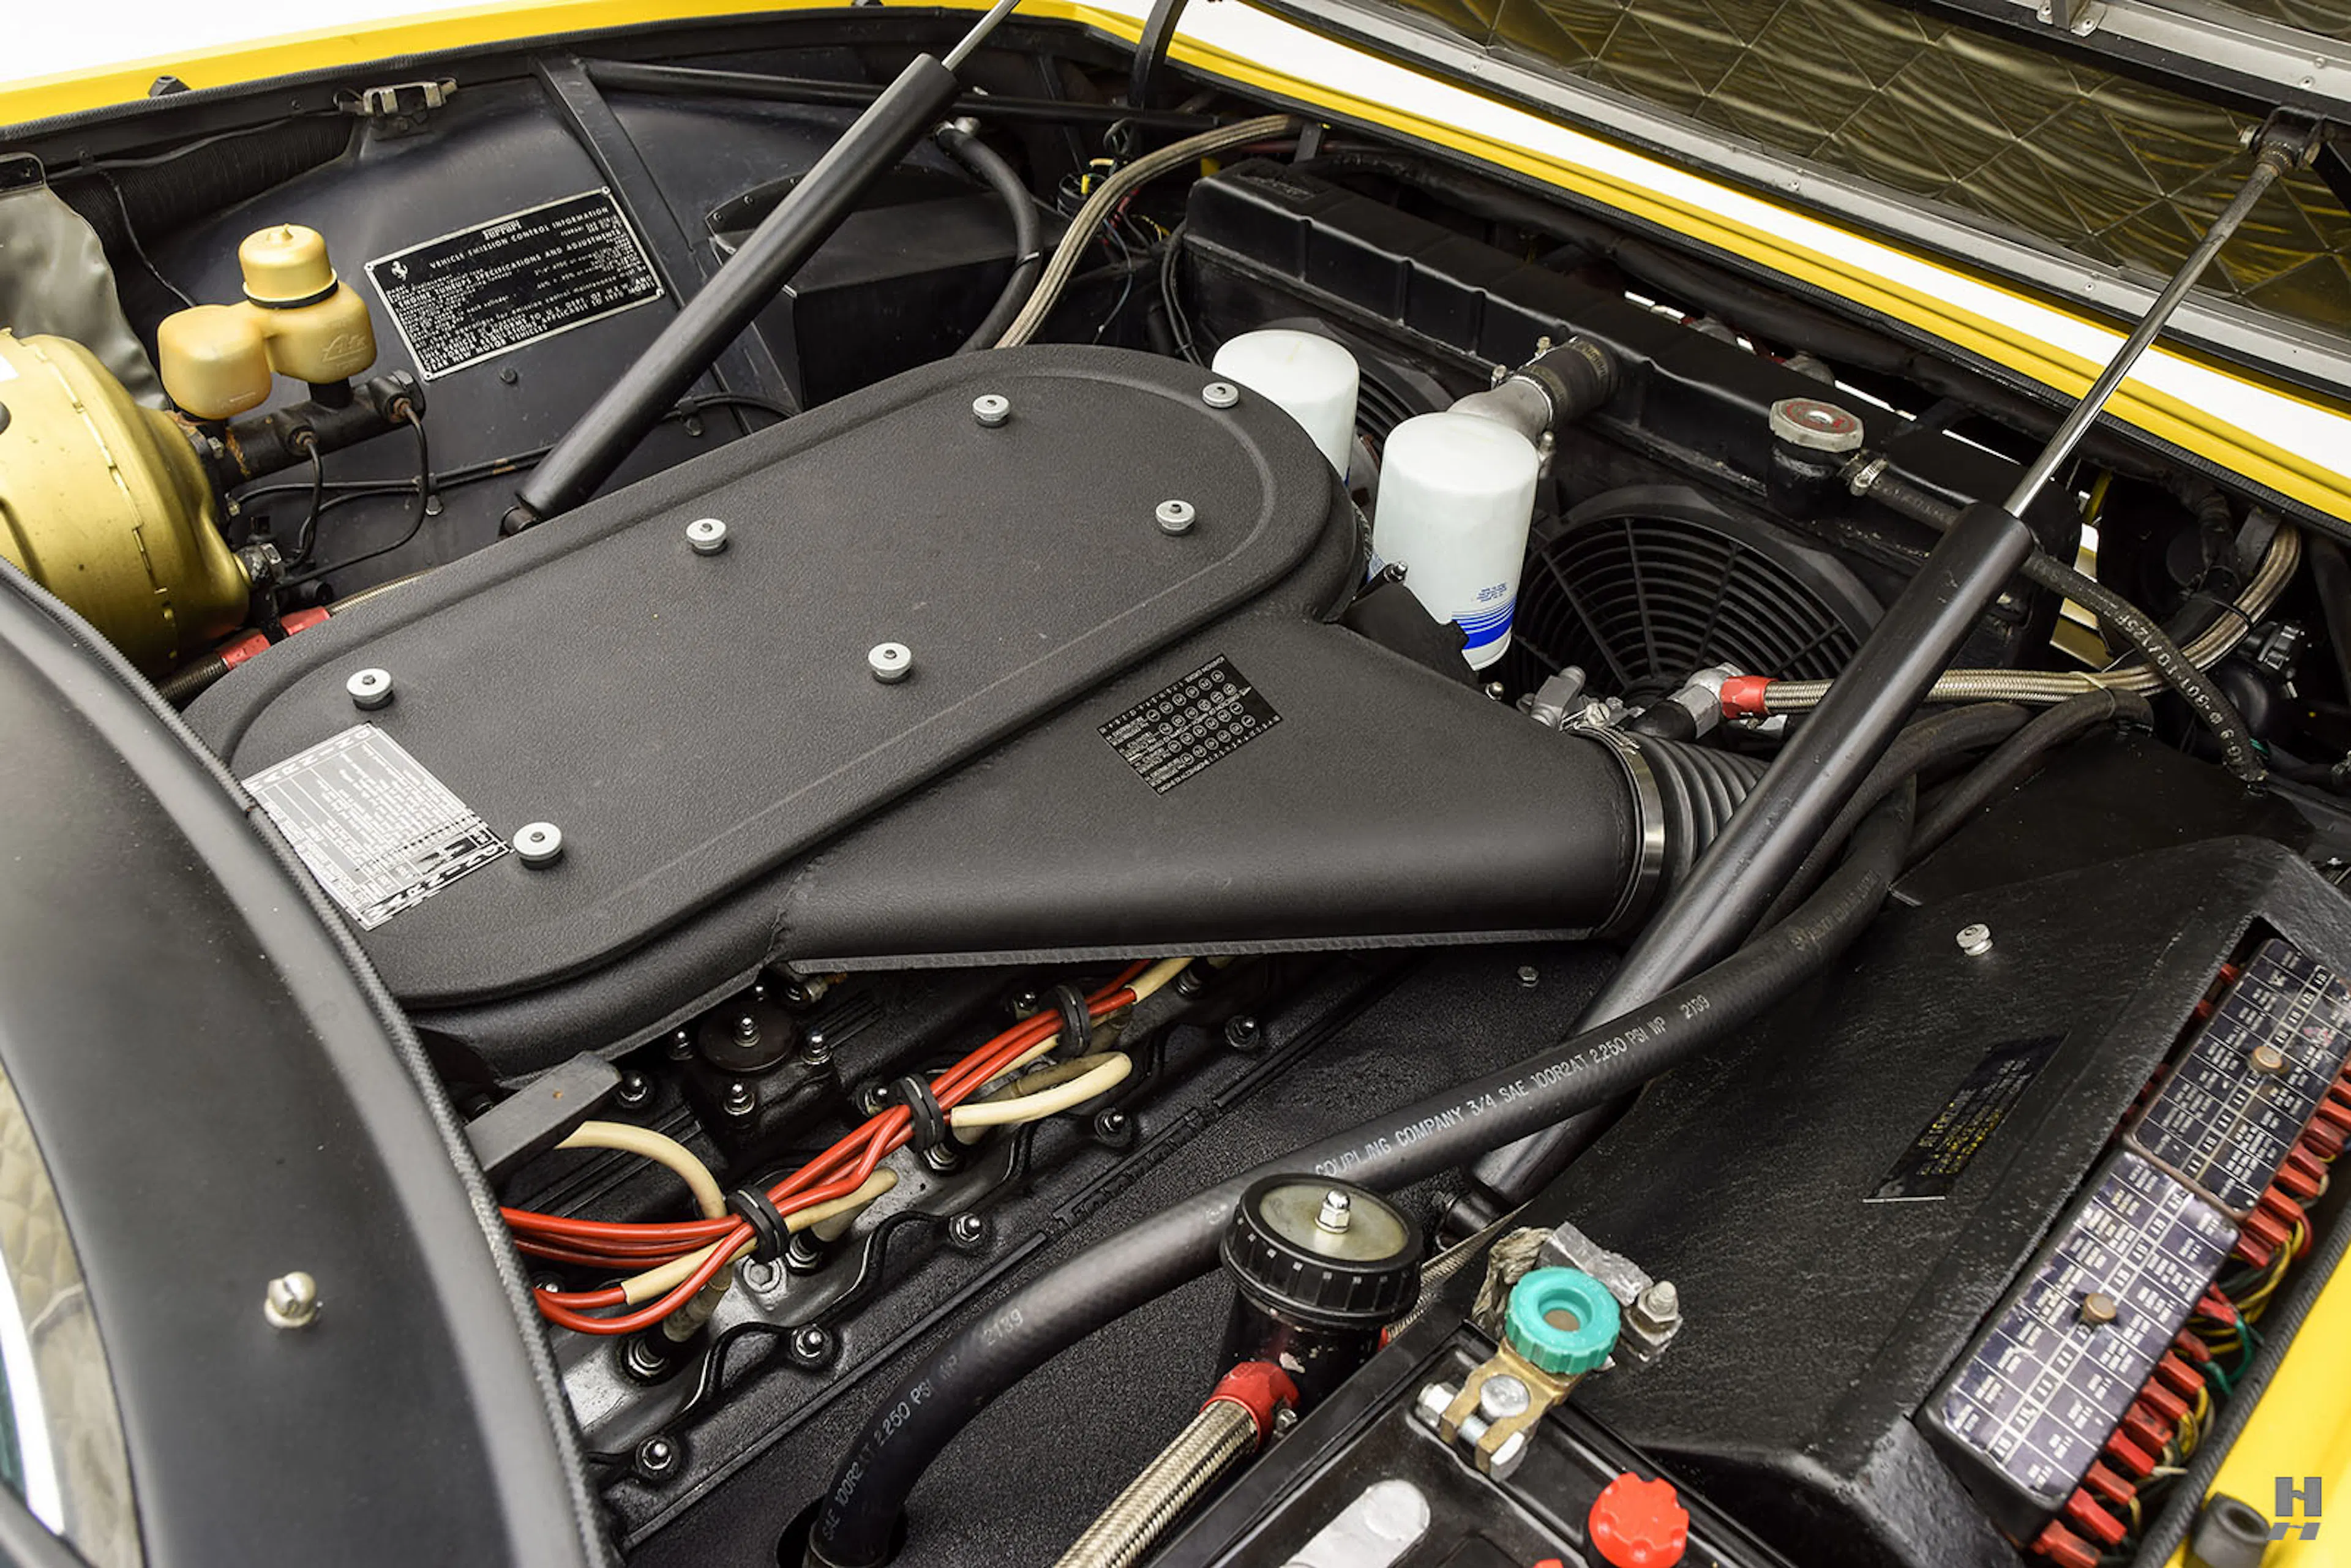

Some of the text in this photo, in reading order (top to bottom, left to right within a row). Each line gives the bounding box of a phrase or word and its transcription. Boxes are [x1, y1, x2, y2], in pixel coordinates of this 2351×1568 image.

[429, 252, 465, 269] VEHICLE
[467, 238, 509, 257] EMISSION
[511, 224, 549, 242] CONTROL
[552, 205, 608, 229] INFORMATION
[482, 219, 521, 240] Ferrari
[544, 247, 563, 258] AND
[1314, 1137, 1392, 1178] COUPLING
[1395, 1105, 1465, 1148] COMPANY
[1466, 1093, 1498, 1116] 3/4
[1498, 1079, 1529, 1103] SAE
[1530, 1054, 1589, 1090] 100R2AT
[1624, 1026, 1651, 1046] PSI
[1681, 994, 1712, 1021] 2139
